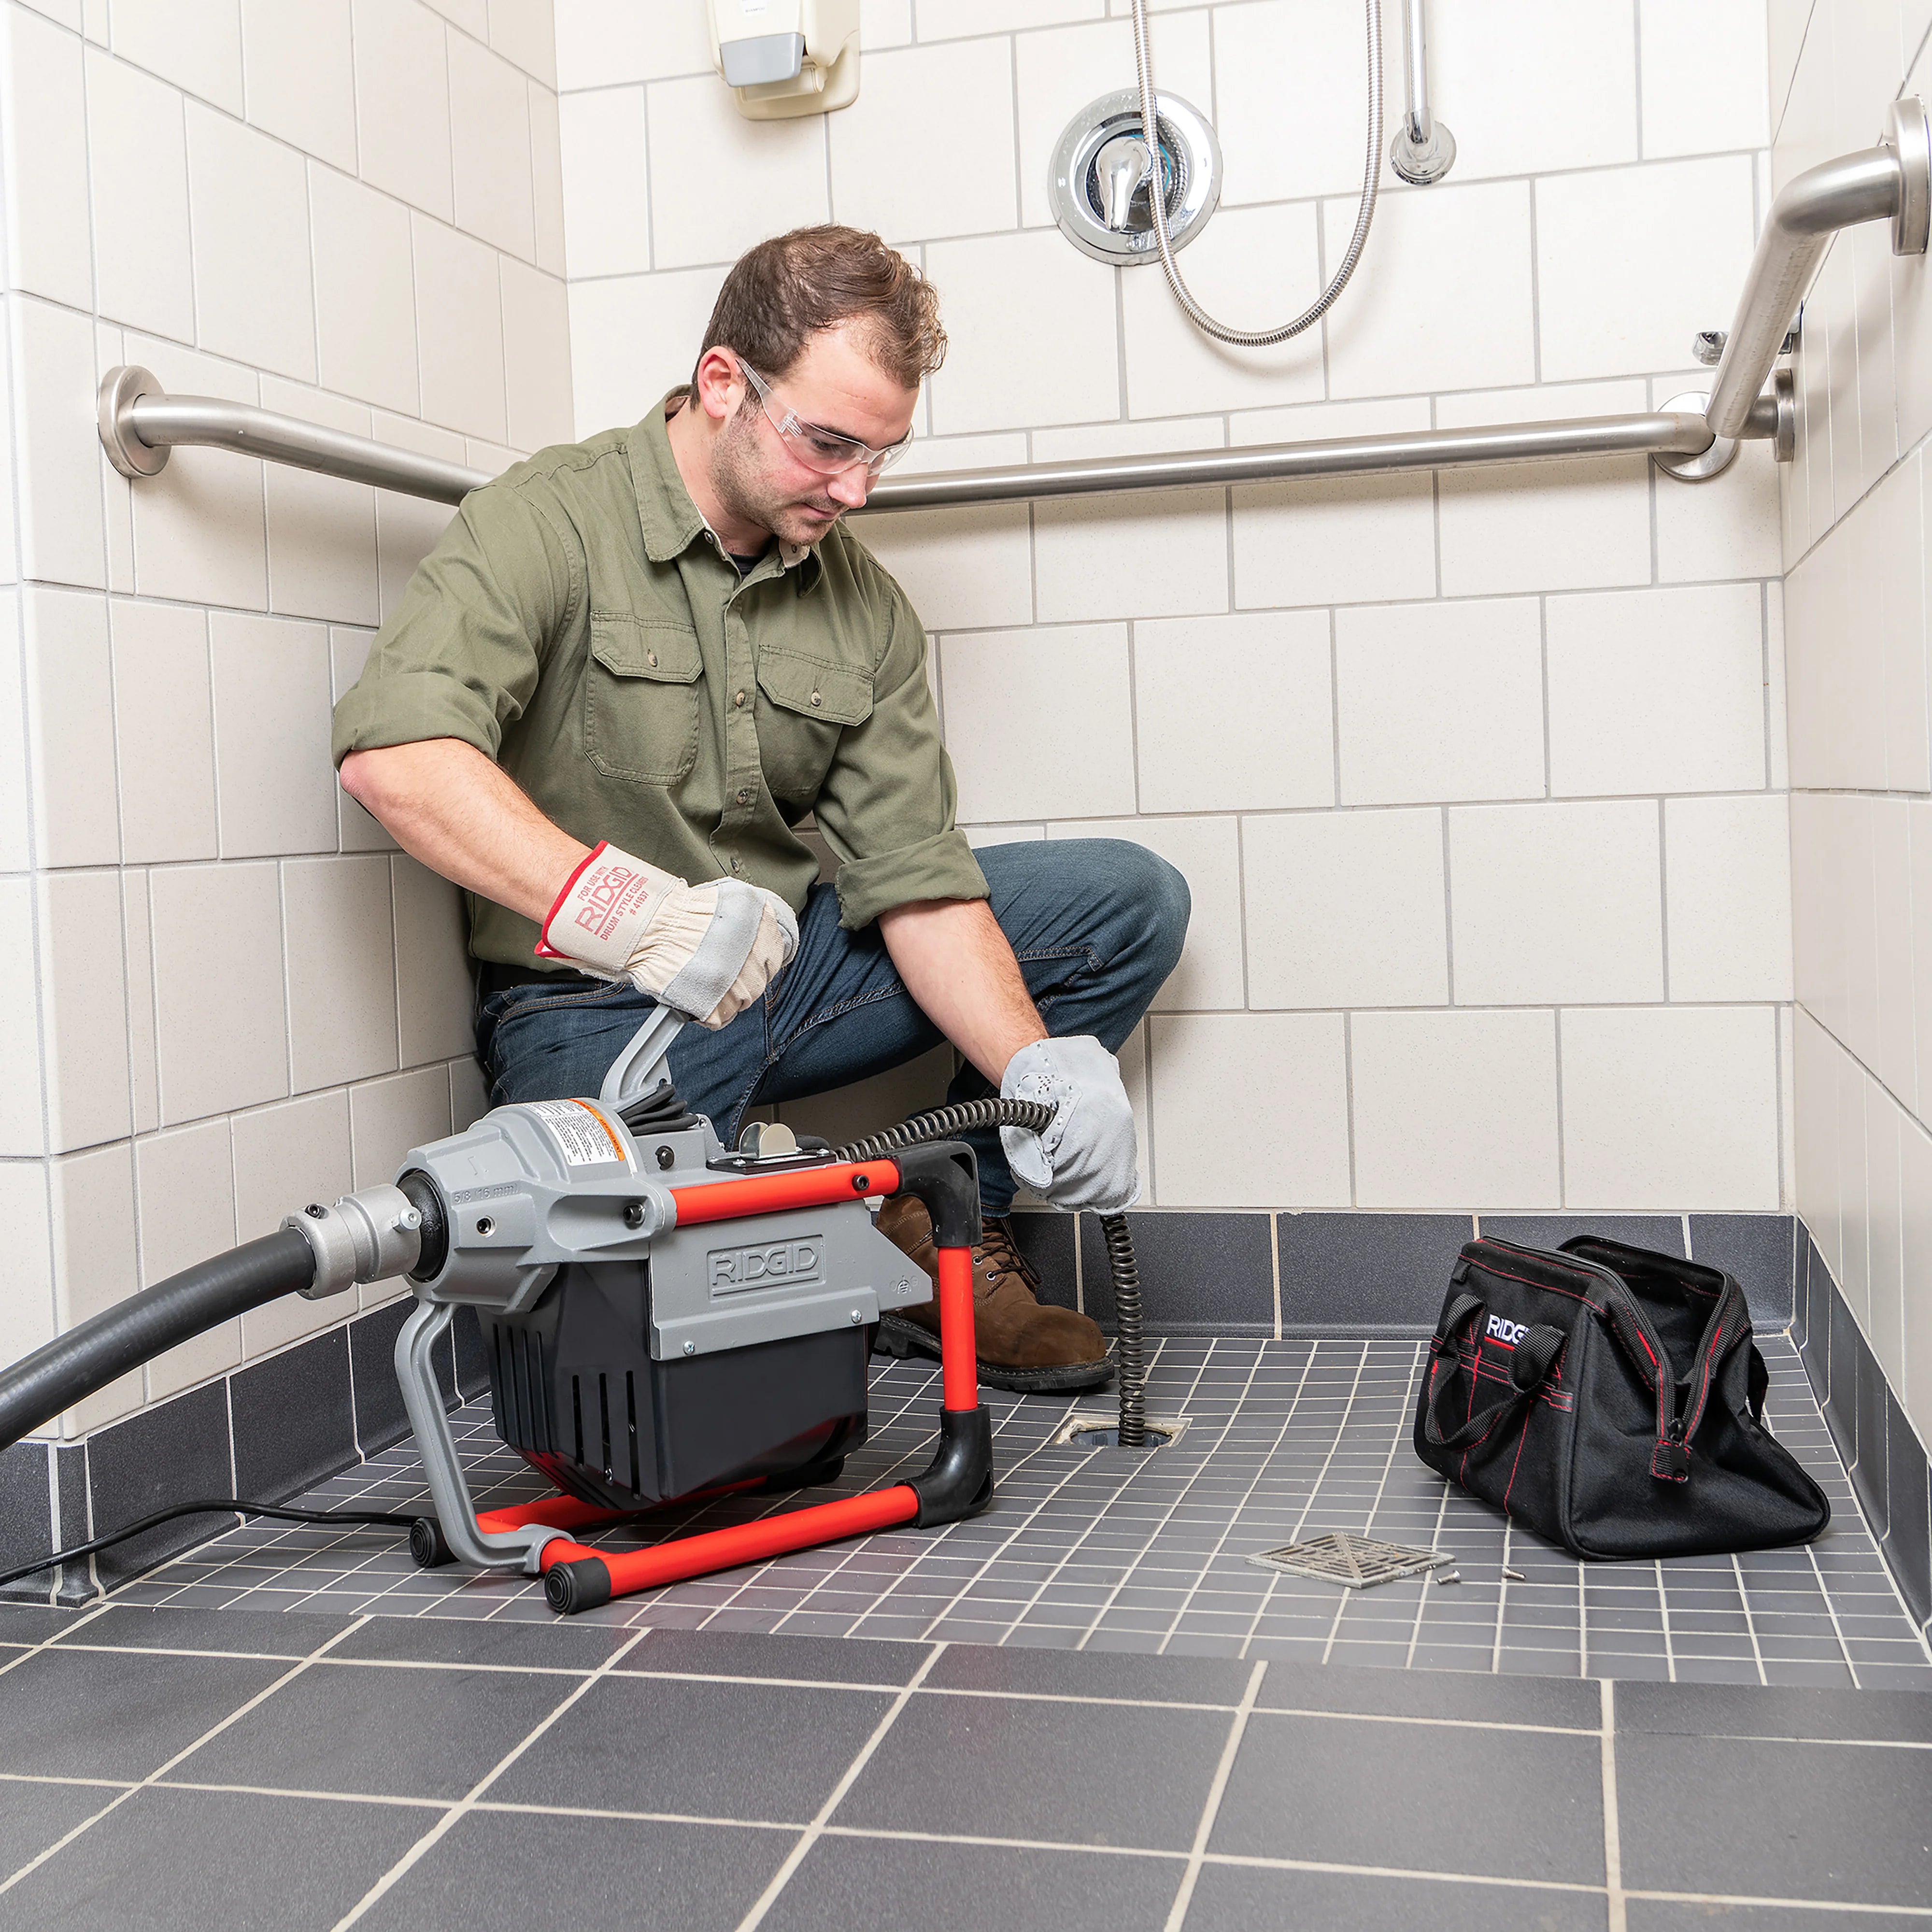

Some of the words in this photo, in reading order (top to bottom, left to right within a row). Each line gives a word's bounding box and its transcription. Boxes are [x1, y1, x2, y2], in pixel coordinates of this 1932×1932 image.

[575, 867, 632, 932] RIDGID
[577, 885, 592, 901] FOR
[587, 874, 600, 887] USE
[633, 891, 650, 909] 41937
[600, 916, 620, 941] DRUM
[615, 893, 634, 916] STYLE
[710, 1242, 819, 1285] RIDGID
[1486, 1314, 1530, 1345] RIDG
